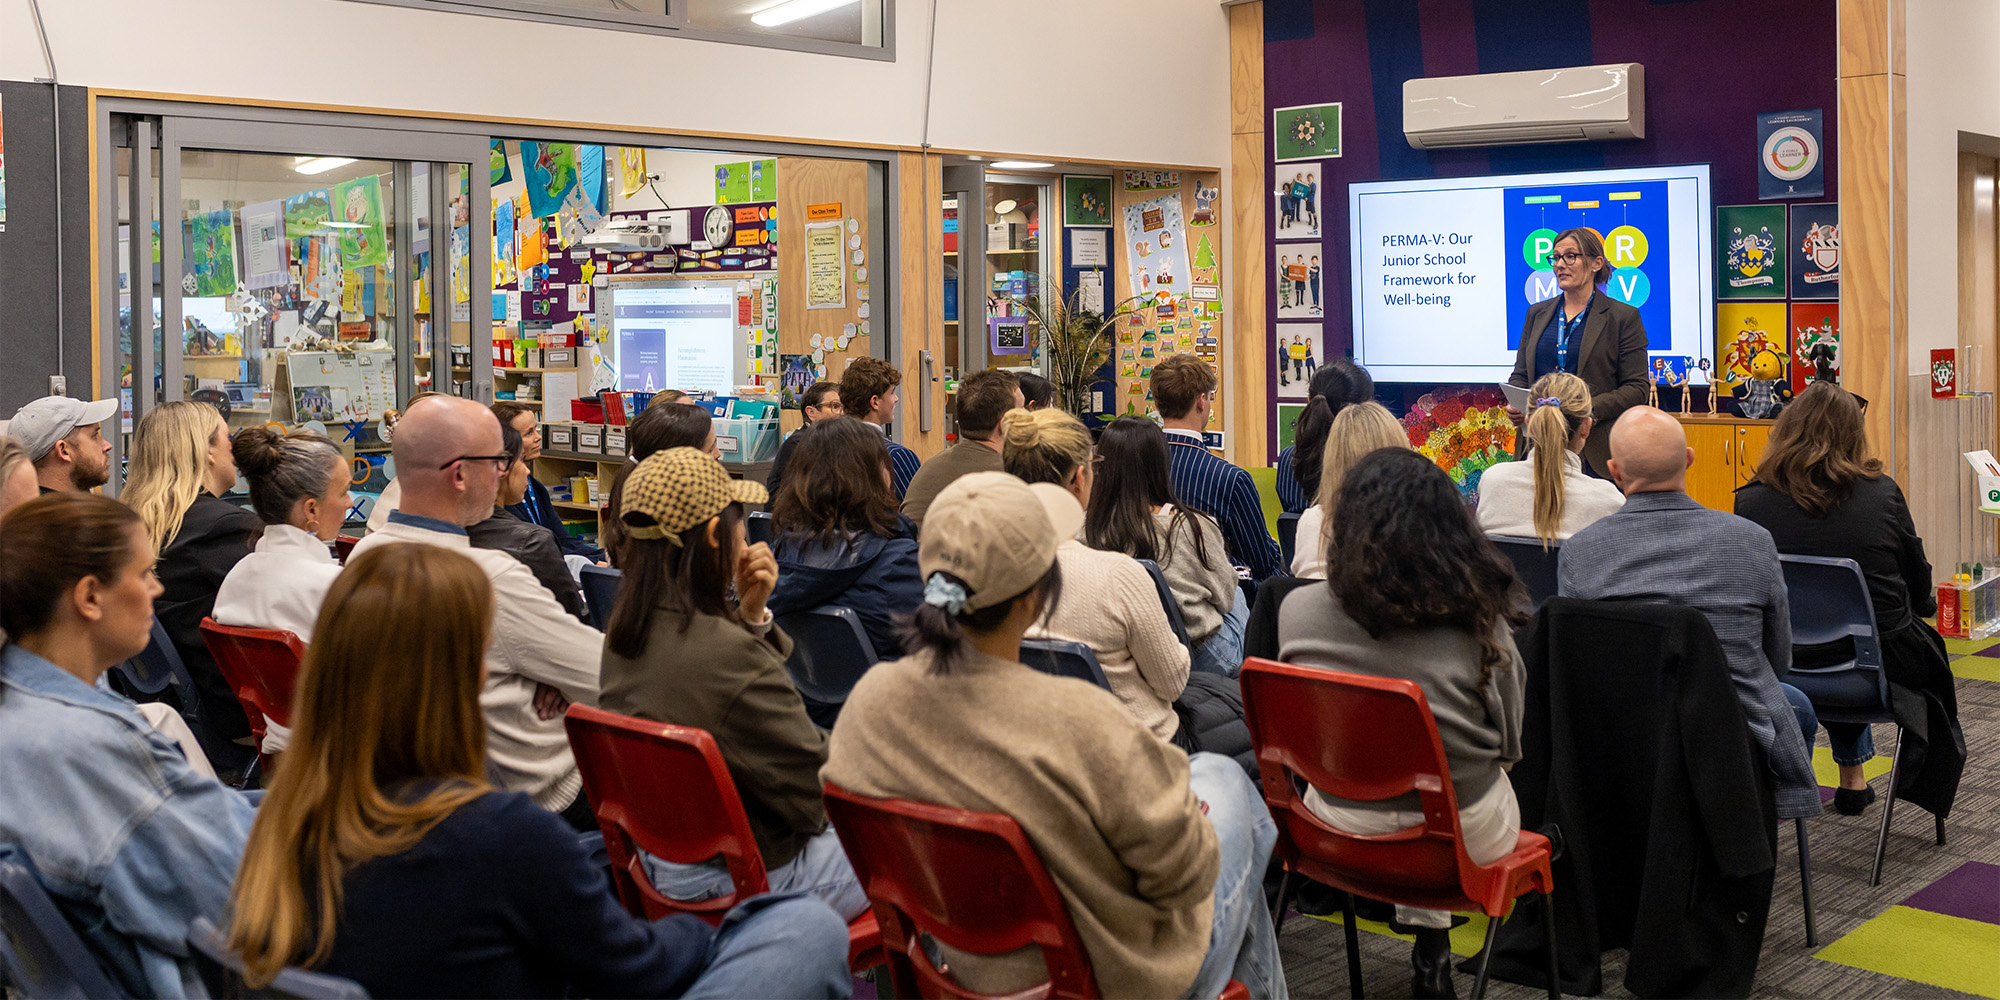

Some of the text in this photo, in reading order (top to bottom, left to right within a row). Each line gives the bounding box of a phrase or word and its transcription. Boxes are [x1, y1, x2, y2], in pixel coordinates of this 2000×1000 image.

[1126, 172, 1178, 183] WELCOME
[1382, 232, 1473, 247] PERMA-V: Our
[1535, 235, 1635, 263] P R
[1382, 252, 1466, 267] Junior School
[1383, 272, 1476, 287] Framework for
[1736, 278, 1765, 286] Thompson
[1535, 275, 1638, 302] M V
[1383, 292, 1451, 307] Well-being
[1656, 359, 1662, 368] E
[1668, 372, 1675, 381] R
[1684, 358, 1693, 367] M
[1728, 373, 1735, 381] V
[783, 371, 811, 388] PATH
[301, 398, 327, 407] PATH
[1992, 492, 1998, 500] P
